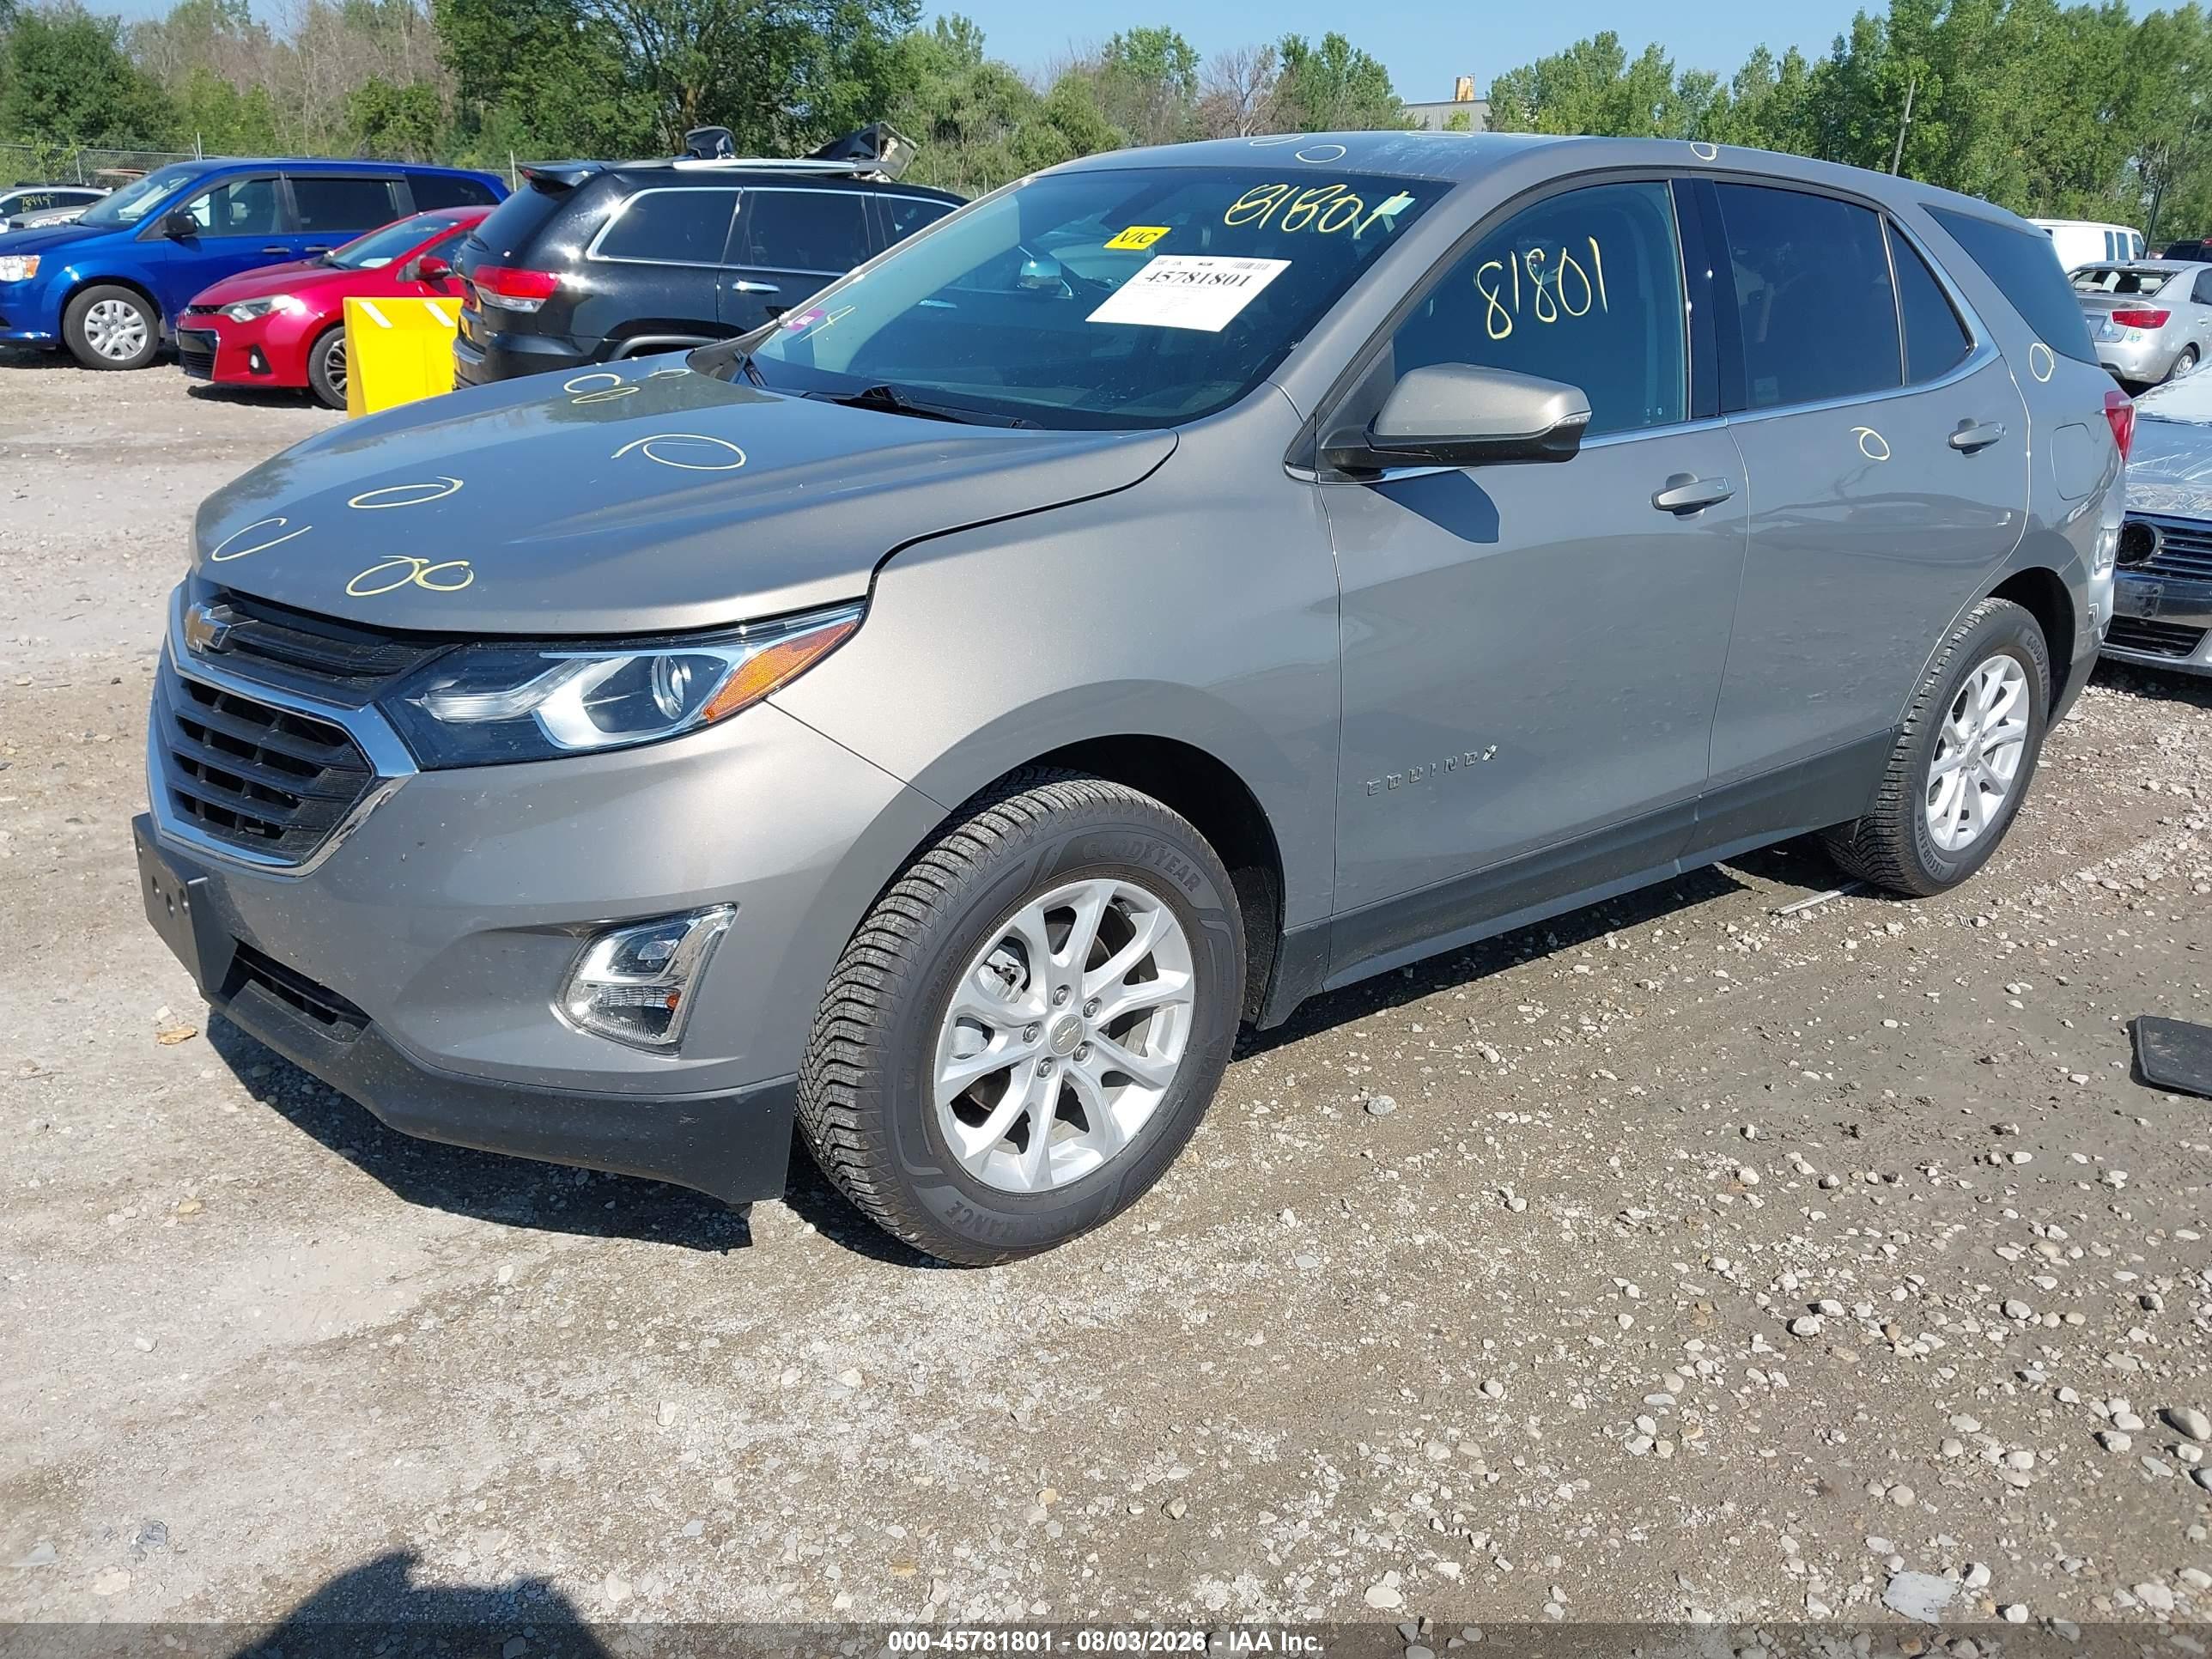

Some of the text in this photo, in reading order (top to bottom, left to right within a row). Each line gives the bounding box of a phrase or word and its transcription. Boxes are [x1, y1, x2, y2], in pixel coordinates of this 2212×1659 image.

[1120, 231, 1158, 243] VIC
[1145, 270, 1254, 287] 45781801
[1474, 236, 1607, 339] 81801
[1367, 744, 1498, 796] EQUINOX
